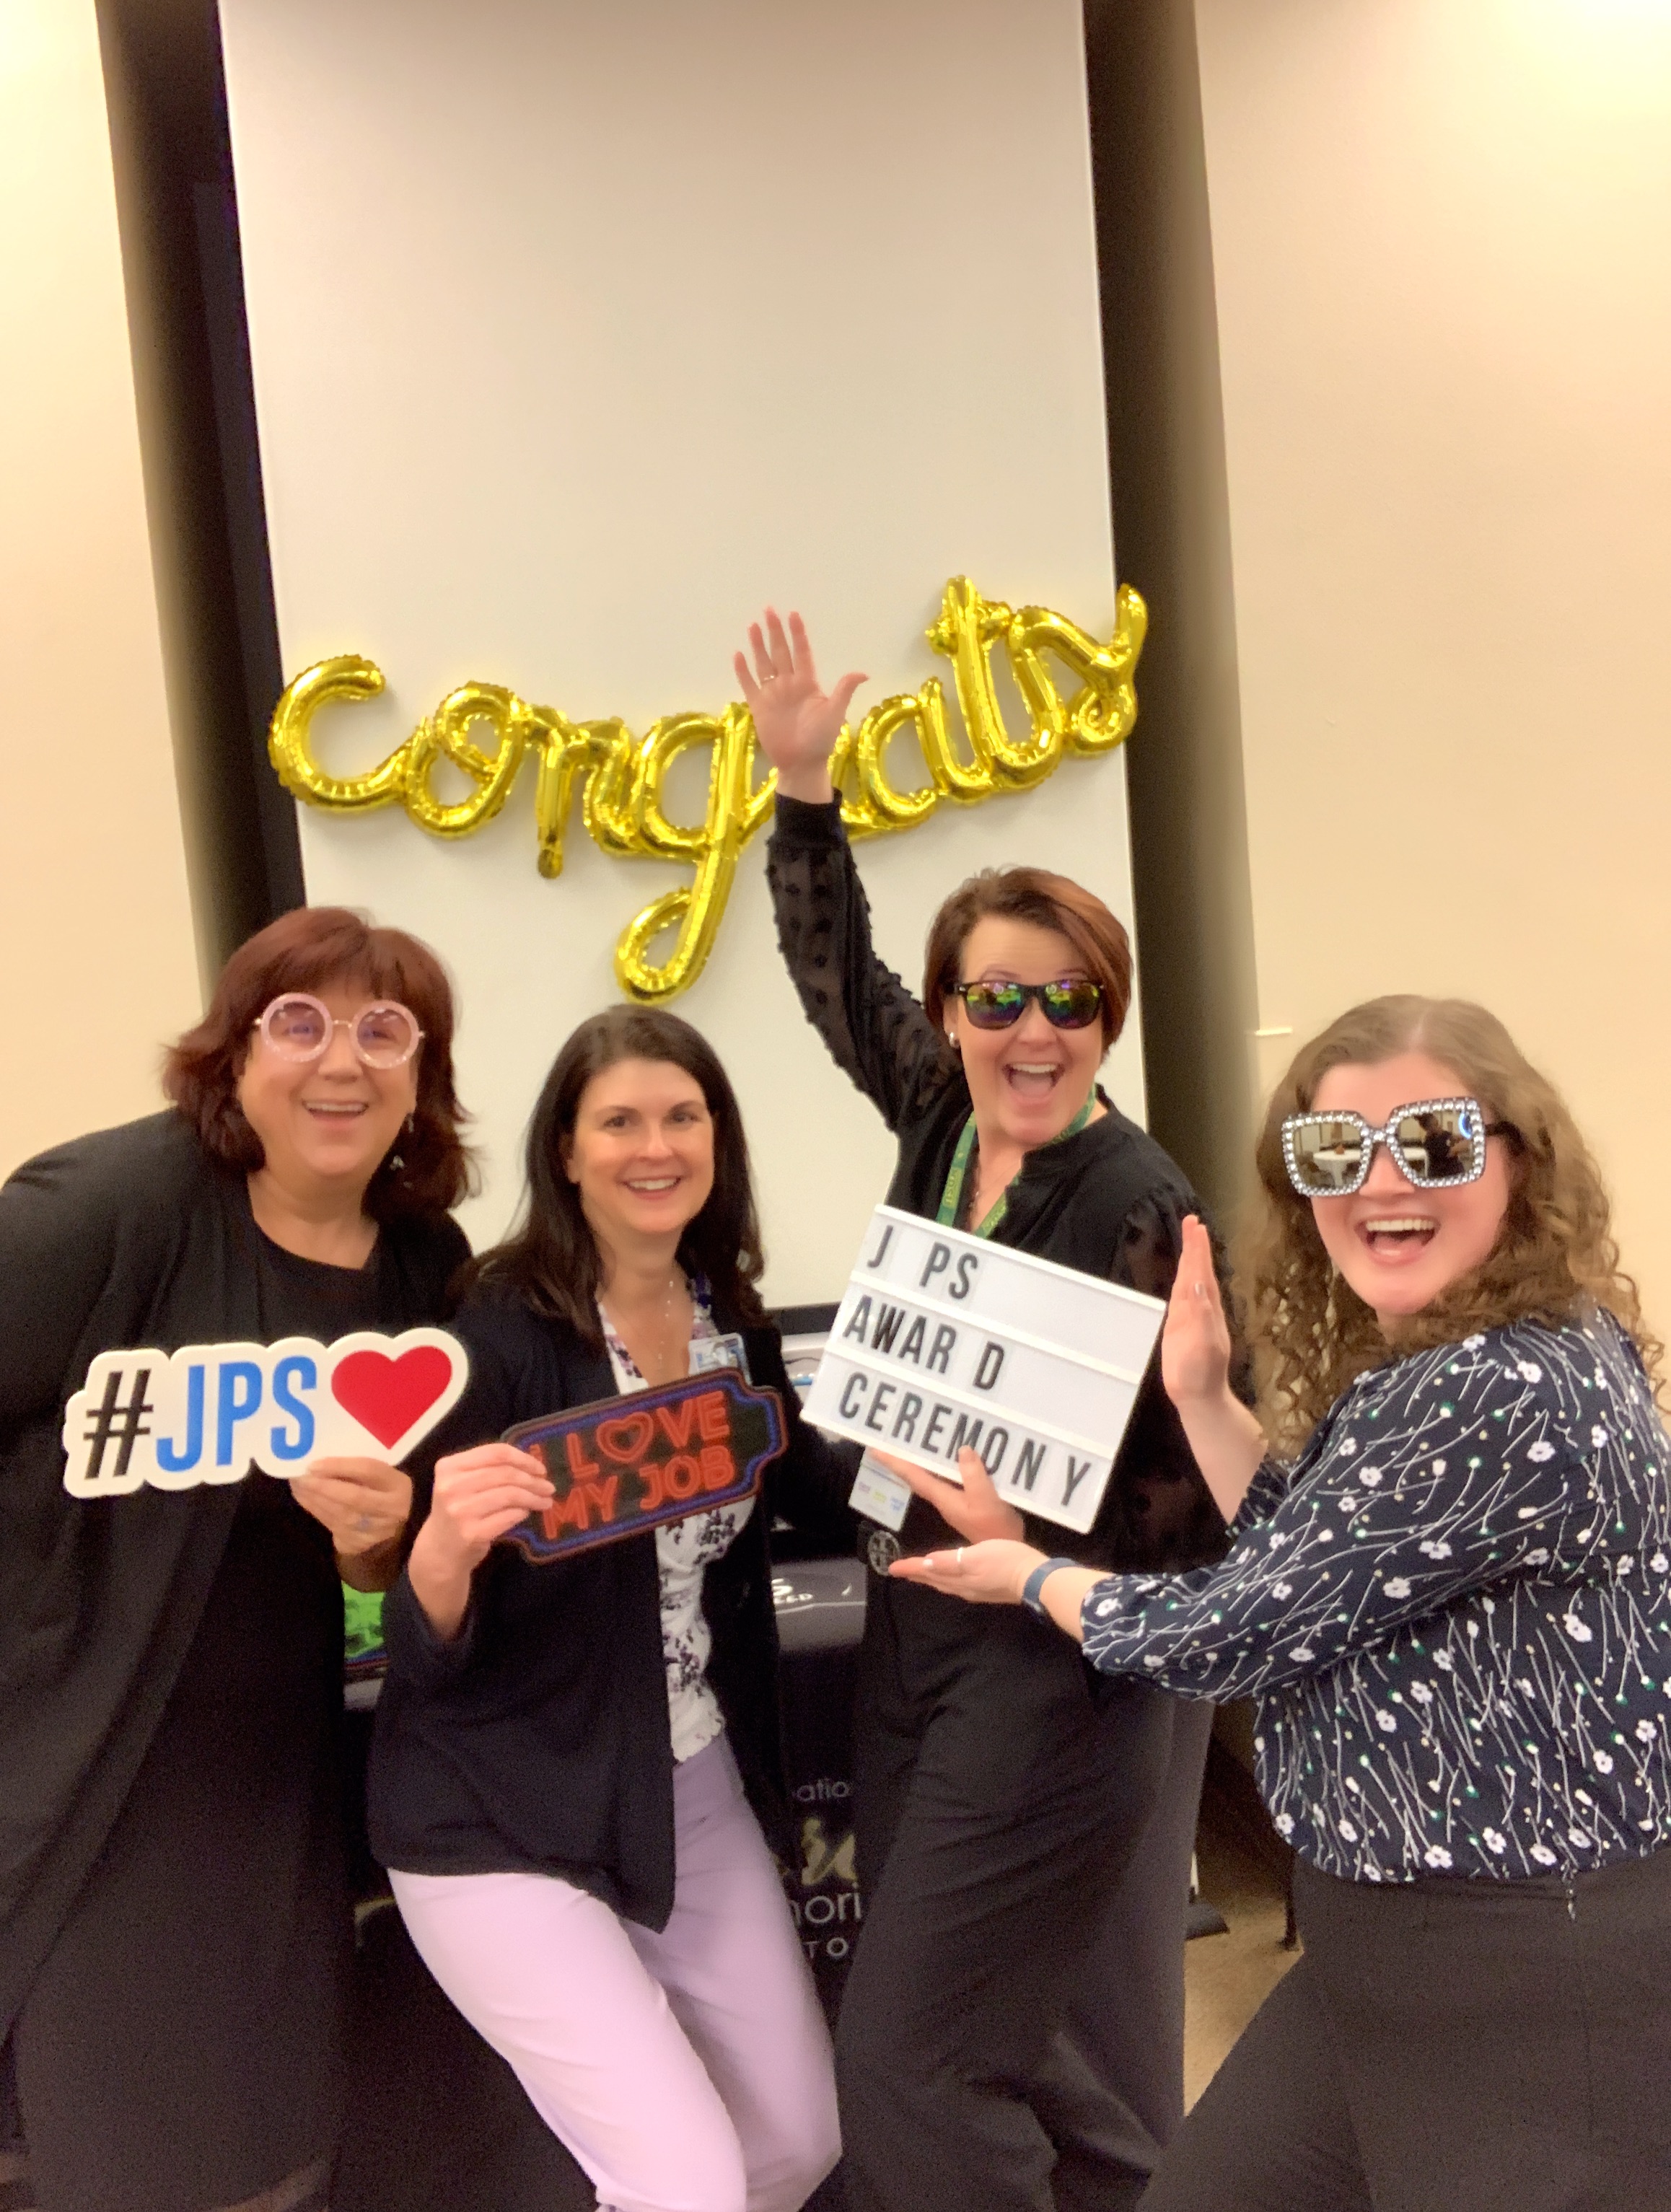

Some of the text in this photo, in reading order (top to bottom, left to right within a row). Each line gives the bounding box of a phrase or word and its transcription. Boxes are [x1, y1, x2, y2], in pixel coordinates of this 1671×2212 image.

[83, 1355, 317, 1480] #JPS
[543, 1445, 735, 1540] MY JOB
